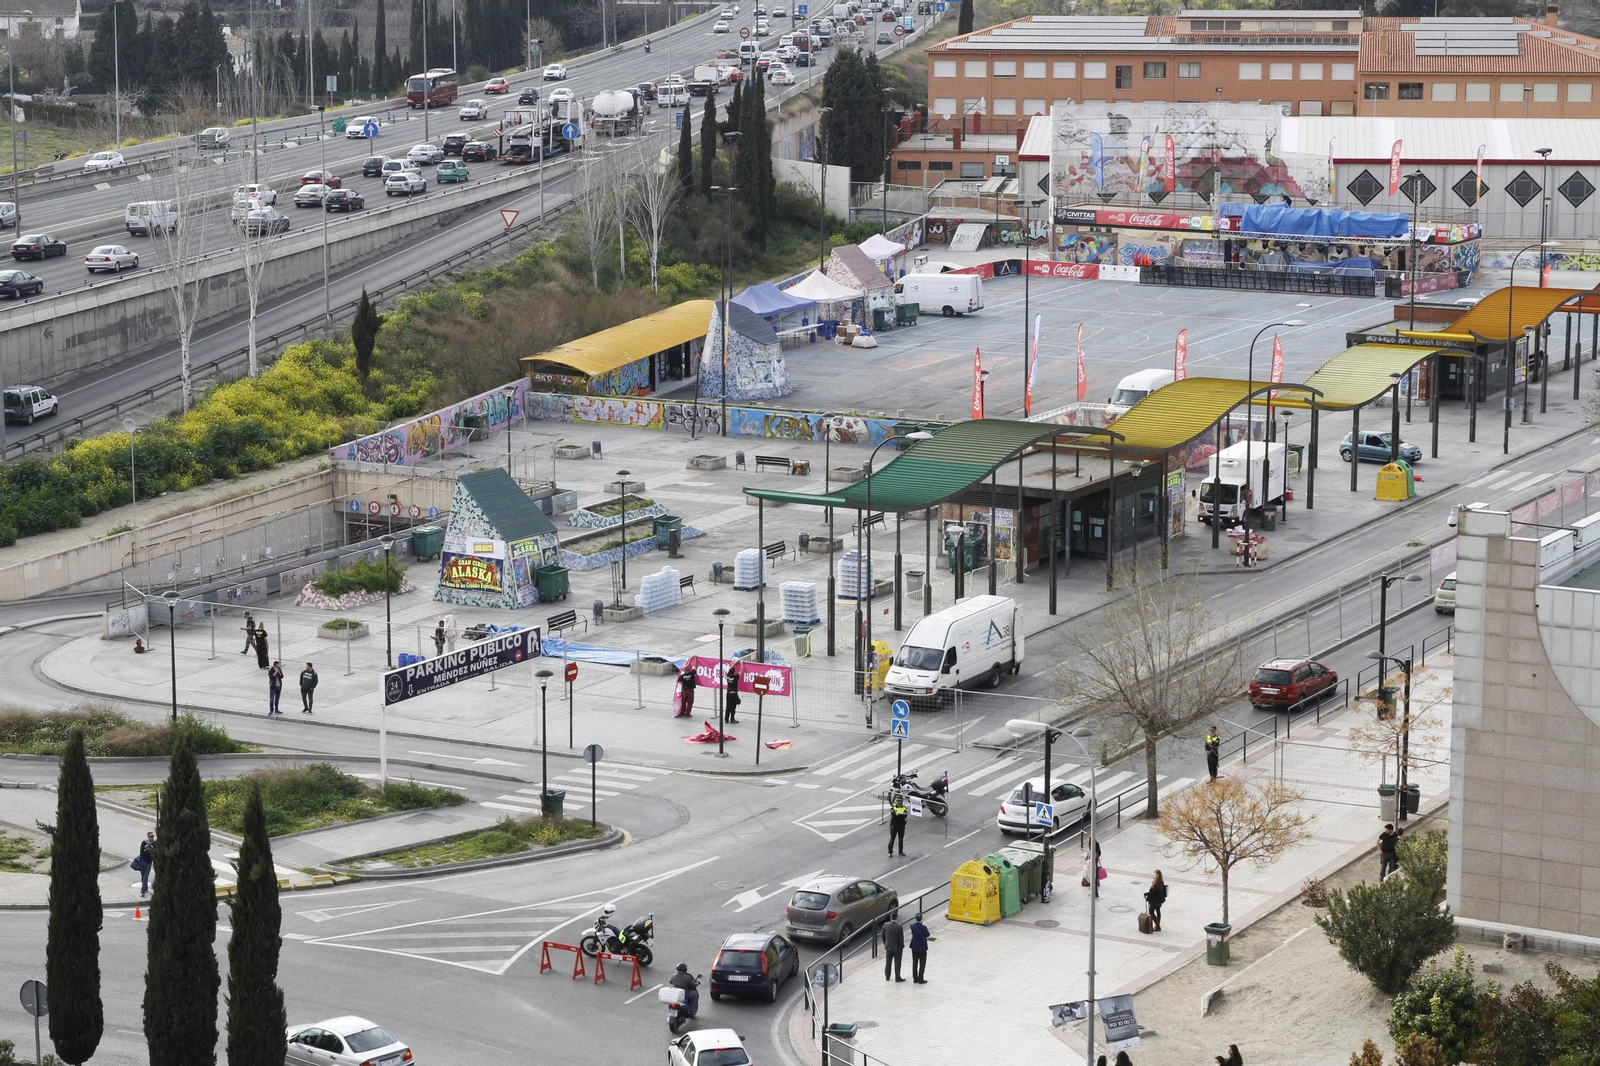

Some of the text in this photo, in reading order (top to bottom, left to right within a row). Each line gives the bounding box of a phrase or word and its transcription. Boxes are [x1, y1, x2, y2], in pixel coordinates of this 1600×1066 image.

[1066, 211, 1095, 219] CIVITTAS
[1129, 213, 1164, 226] Coca-Cola
[1053, 263, 1086, 277] Coca-Cola
[513, 544, 538, 557] ALASKA
[472, 560, 488, 569] CIRCO
[452, 565, 492, 583] ALASKA
[406, 651, 466, 682] PARKING
[433, 664, 468, 684] MÉNDEZ
[470, 655, 498, 671] NÚÑEZ
[692, 665, 712, 679] OLI
[416, 680, 450, 695] ENTRADA
[483, 660, 514, 673] SALIDA
[390, 681, 398, 690] 24
